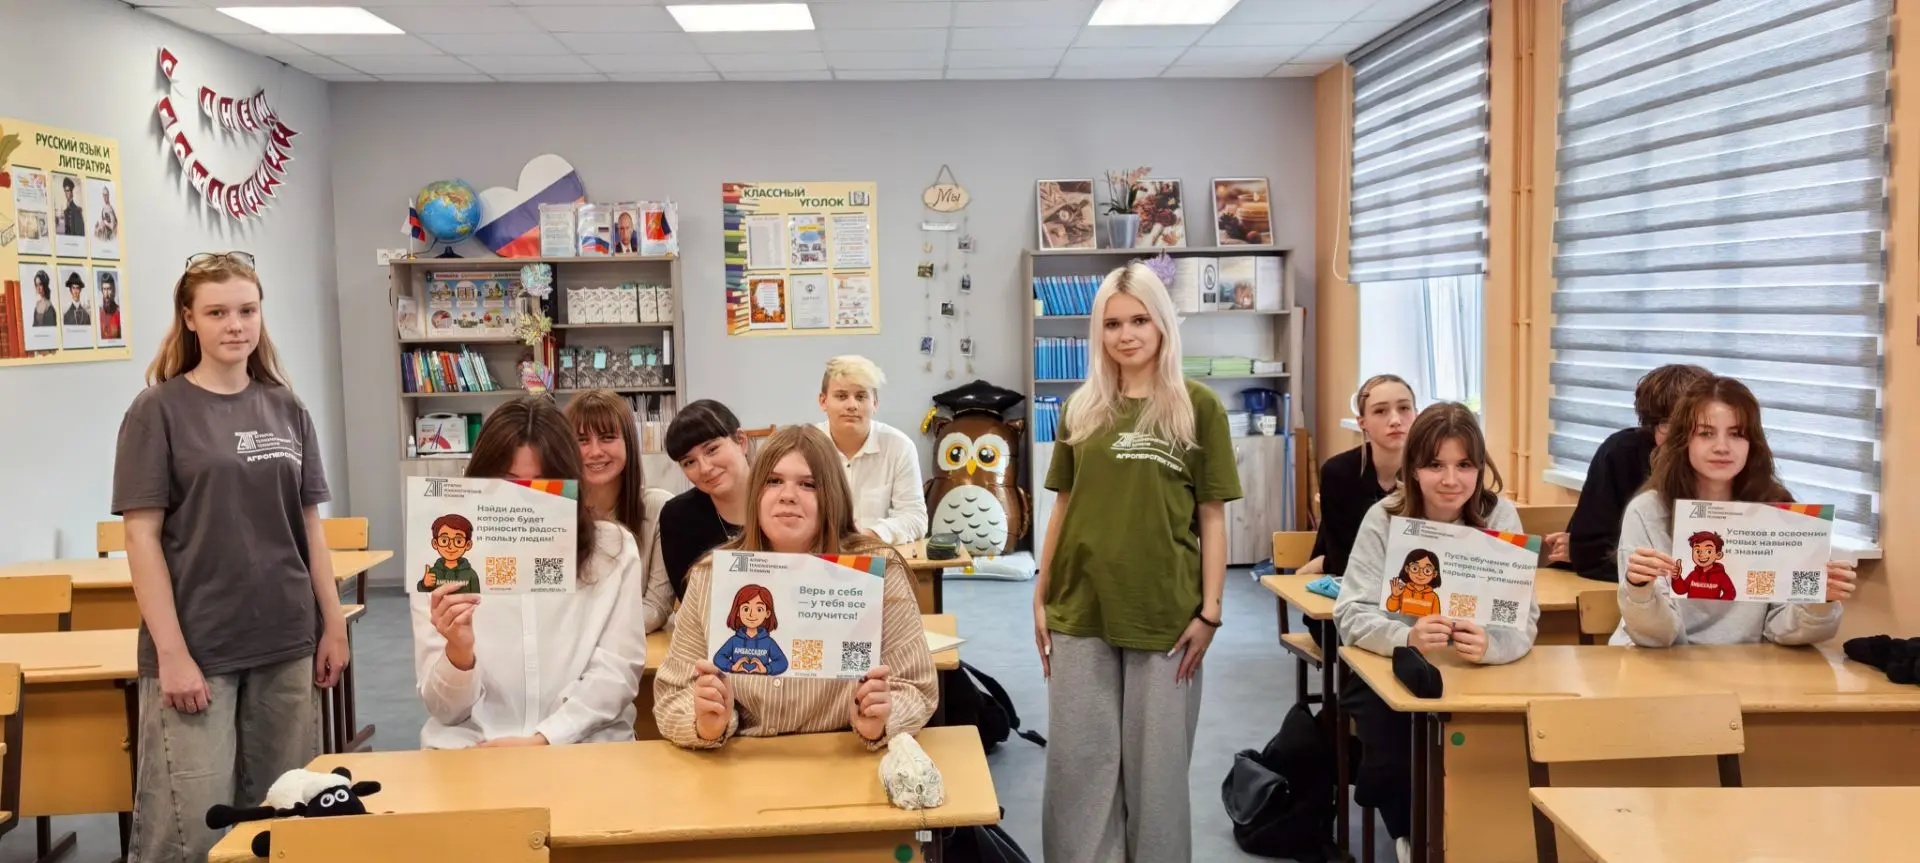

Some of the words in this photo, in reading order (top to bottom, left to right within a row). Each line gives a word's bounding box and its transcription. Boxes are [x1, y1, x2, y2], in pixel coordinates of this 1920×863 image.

[36, 133, 77, 152] РУССКИЙ
[79, 142, 101, 157] ЯЗЫК
[103, 147, 110, 158] И
[59, 155, 111, 174] ЛИТЕРАТУРА
[743, 186, 806, 198] КЛАССНЫЙ
[933, 188, 961, 207] Мы
[799, 198, 844, 208] УГОЛОК
[477, 504, 507, 514] Найди
[509, 505, 535, 514] дело,
[477, 515, 515, 525] которое
[517, 514, 545, 526] будет
[476, 525, 527, 535] приносить
[529, 526, 567, 535] радость
[1726, 528, 1767, 538] Успехов
[485, 535, 517, 544] пользу
[519, 534, 555, 543] людям!
[1726, 539, 1758, 547] новых
[1760, 540, 1803, 548] навыков
[1734, 548, 1774, 556] знаний!
[1444, 551, 1469, 562] Пусть
[1470, 556, 1510, 568] обучение
[1512, 561, 1537, 571] будет
[1443, 560, 1497, 576] интересным,
[1442, 569, 1477, 580] карьера
[1487, 574, 1533, 587] успешной!
[799, 586, 826, 596] Верь
[837, 587, 863, 597] себя
[811, 600, 817, 608] у
[820, 600, 845, 608] тебя
[798, 611, 858, 622] получится!
